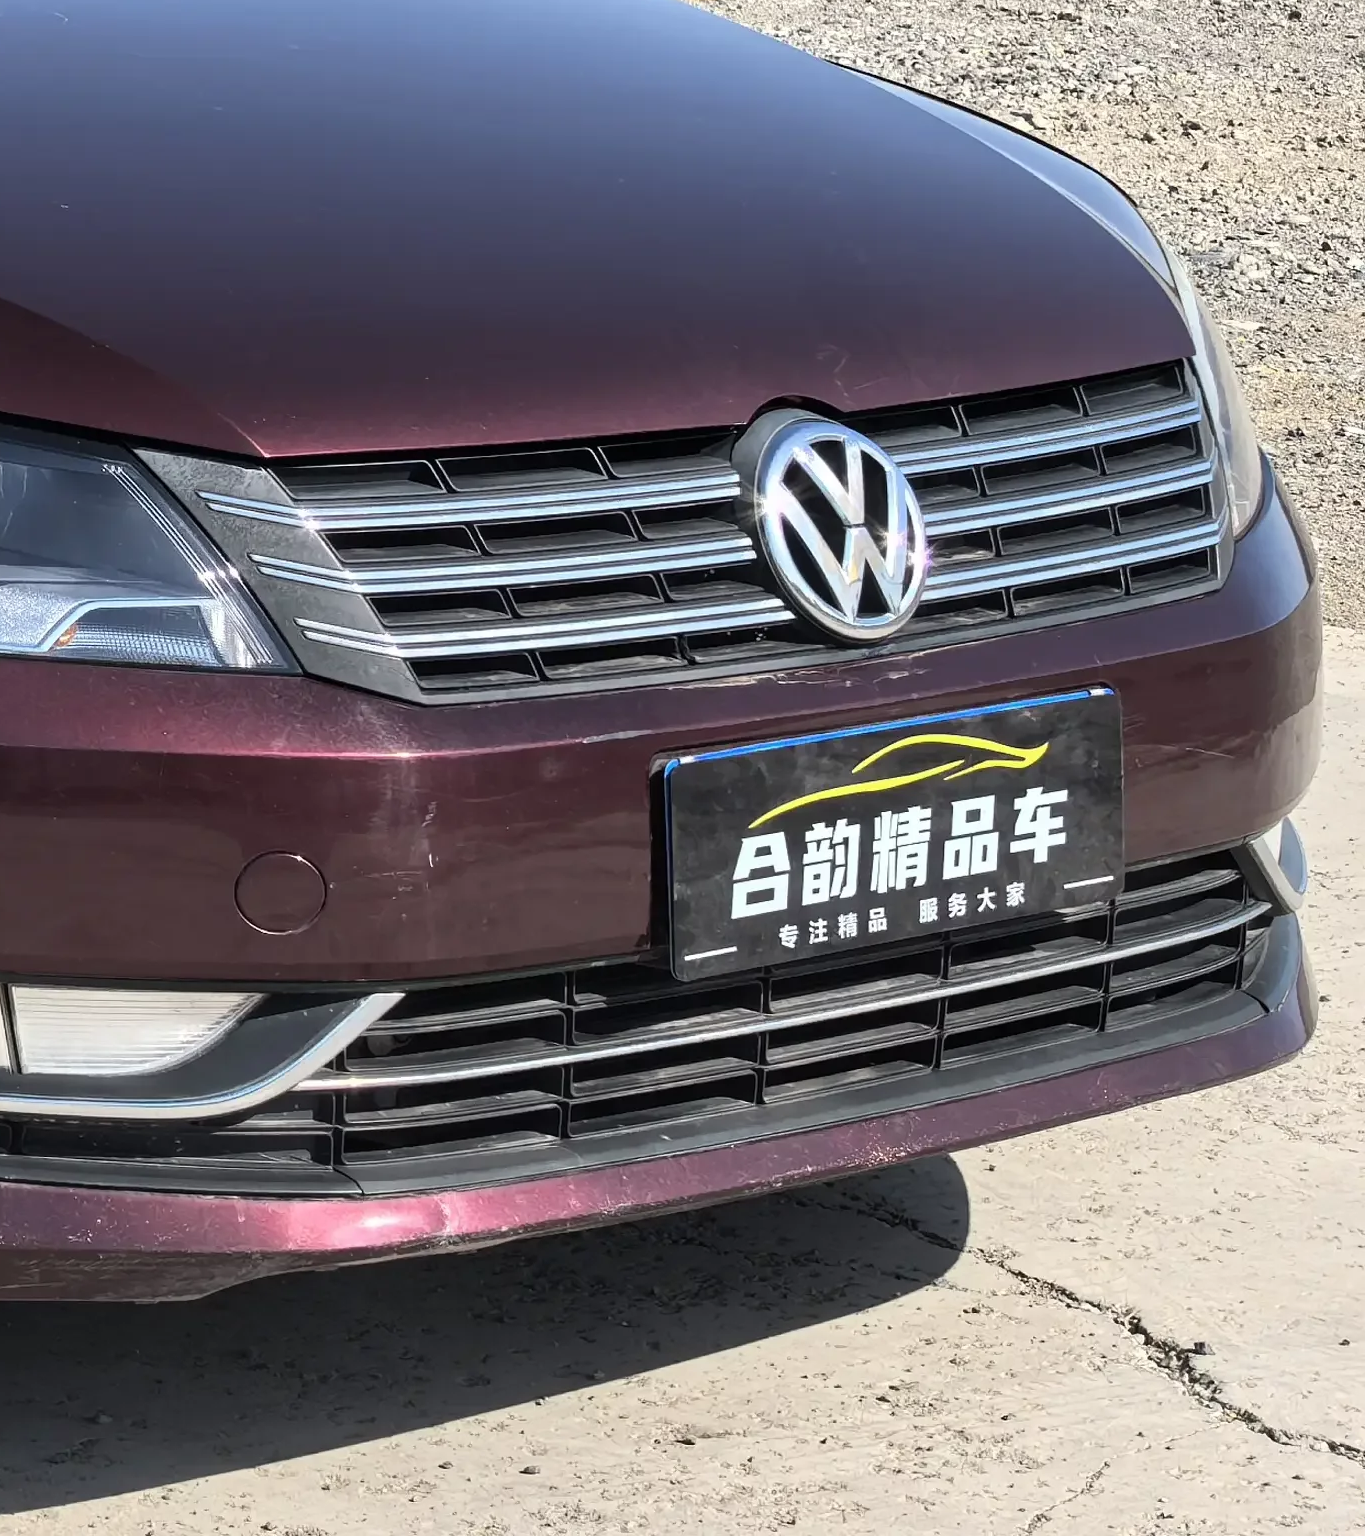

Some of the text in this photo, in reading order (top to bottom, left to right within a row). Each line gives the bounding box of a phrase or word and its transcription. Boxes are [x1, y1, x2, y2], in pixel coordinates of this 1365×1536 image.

[730, 785, 1069, 920] 合韵精品车
[778, 881, 1026, 949] 专注精品 服务大家
